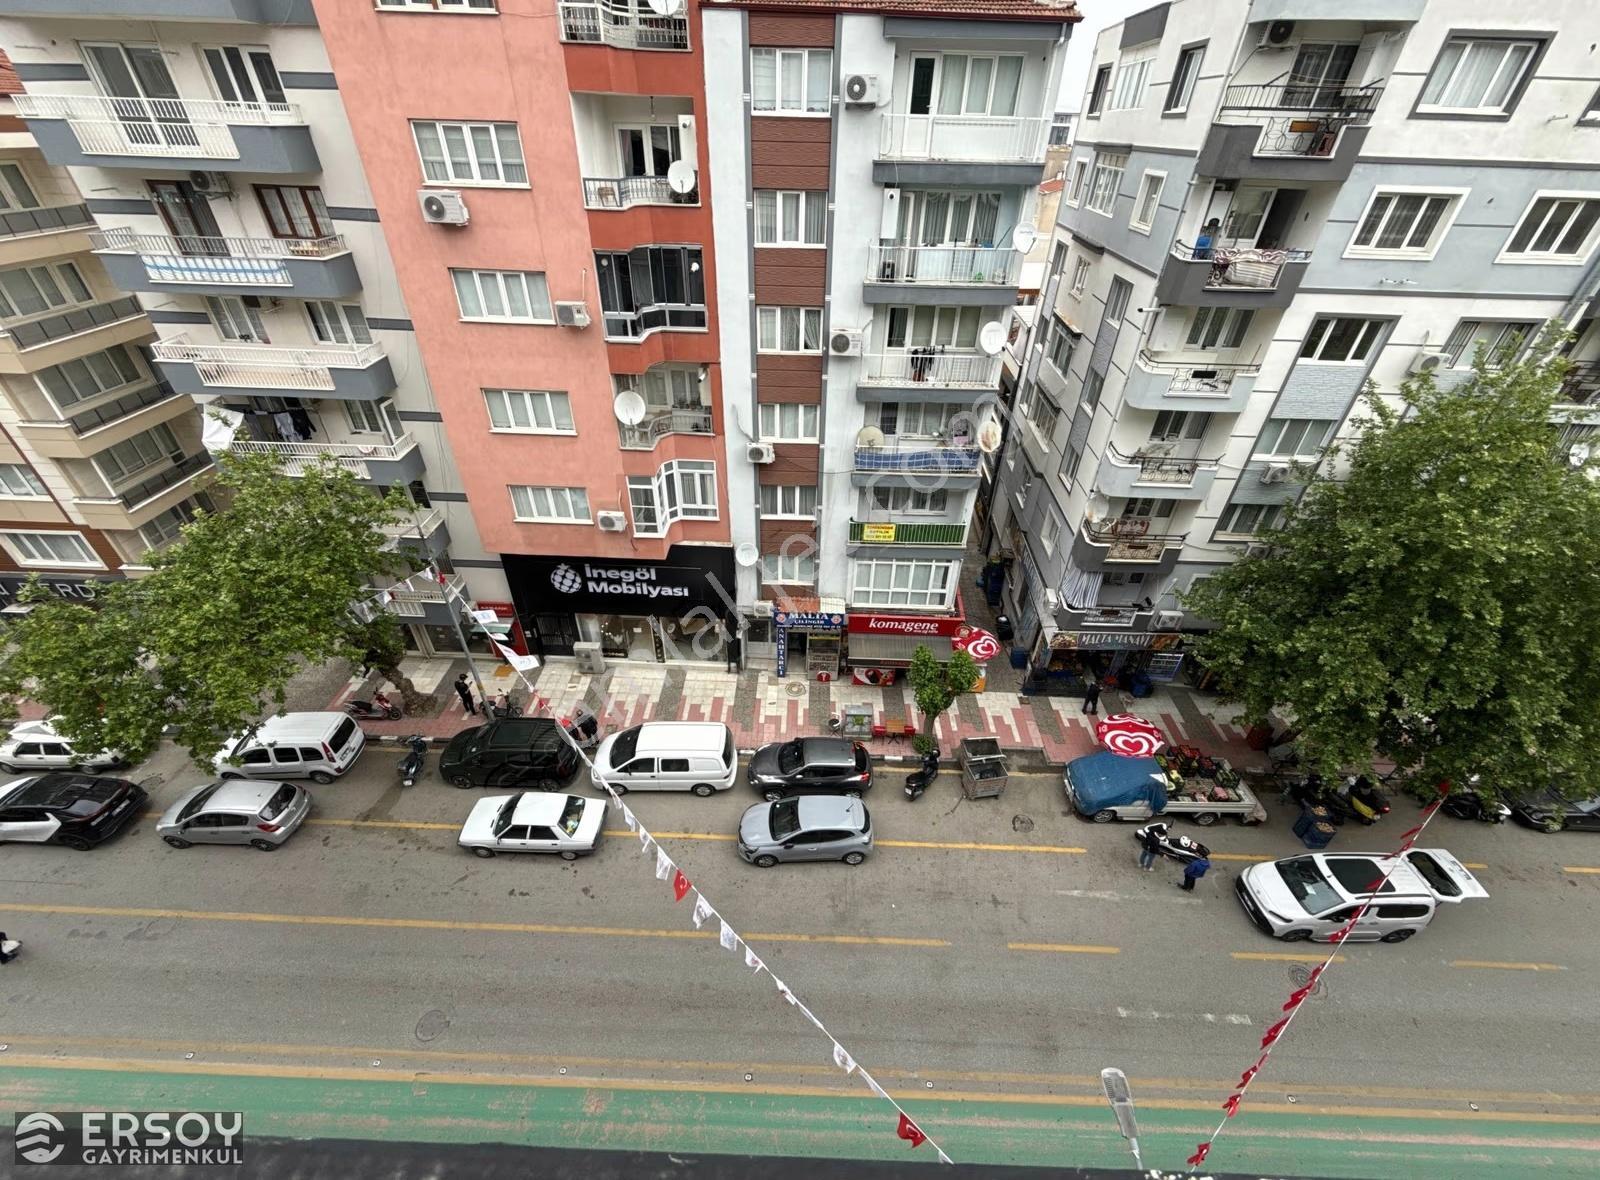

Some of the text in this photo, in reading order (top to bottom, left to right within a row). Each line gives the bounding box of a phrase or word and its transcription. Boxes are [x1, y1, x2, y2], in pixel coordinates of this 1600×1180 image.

[584, 563, 657, 583] İnegöl
[587, 581, 690, 598] Mobilyası
[868, 617, 939, 633] komagene
